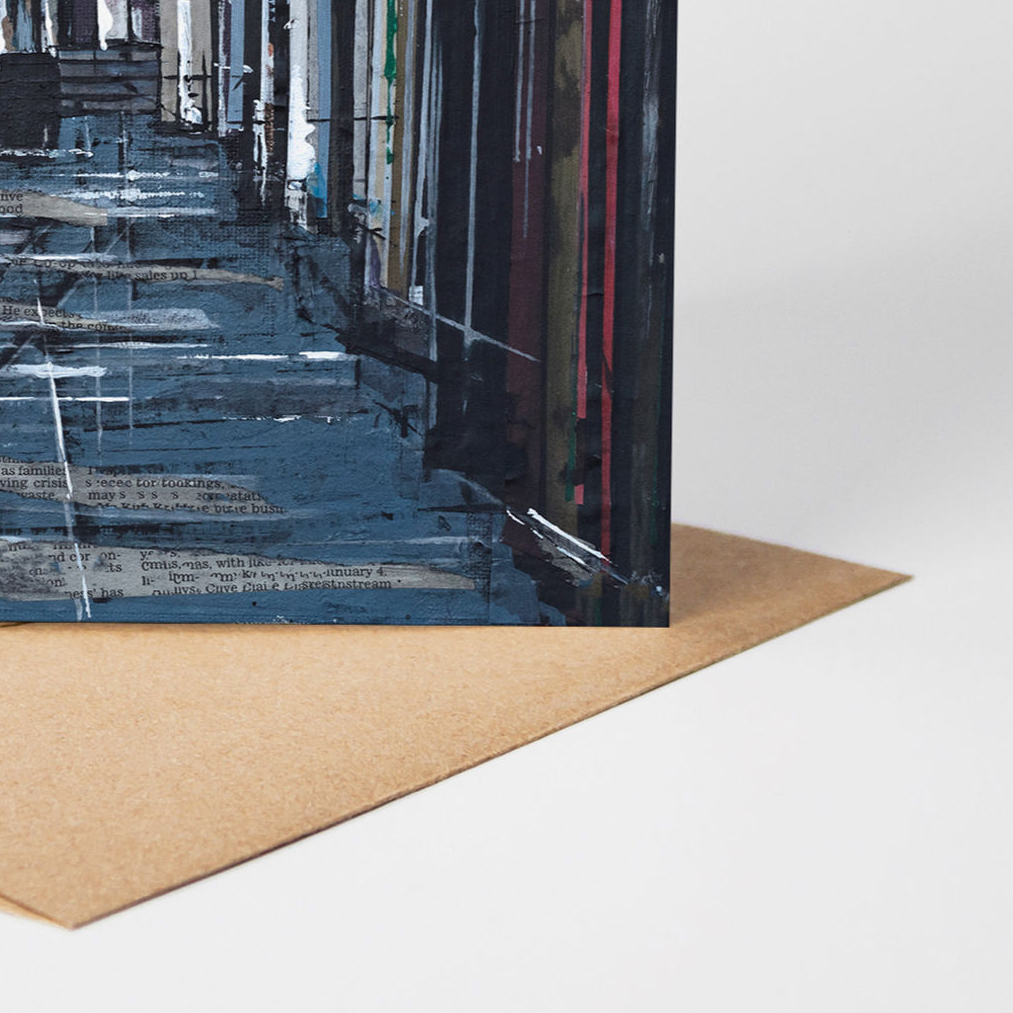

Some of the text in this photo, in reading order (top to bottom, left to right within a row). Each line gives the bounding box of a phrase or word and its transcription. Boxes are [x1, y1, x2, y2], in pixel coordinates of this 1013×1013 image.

[1, 306, 21, 316] He
[1, 467, 15, 475] as
[18, 465, 67, 476] families
[88, 491, 116, 501] may
[216, 557, 244, 568] with
[101, 588, 124, 598] has
